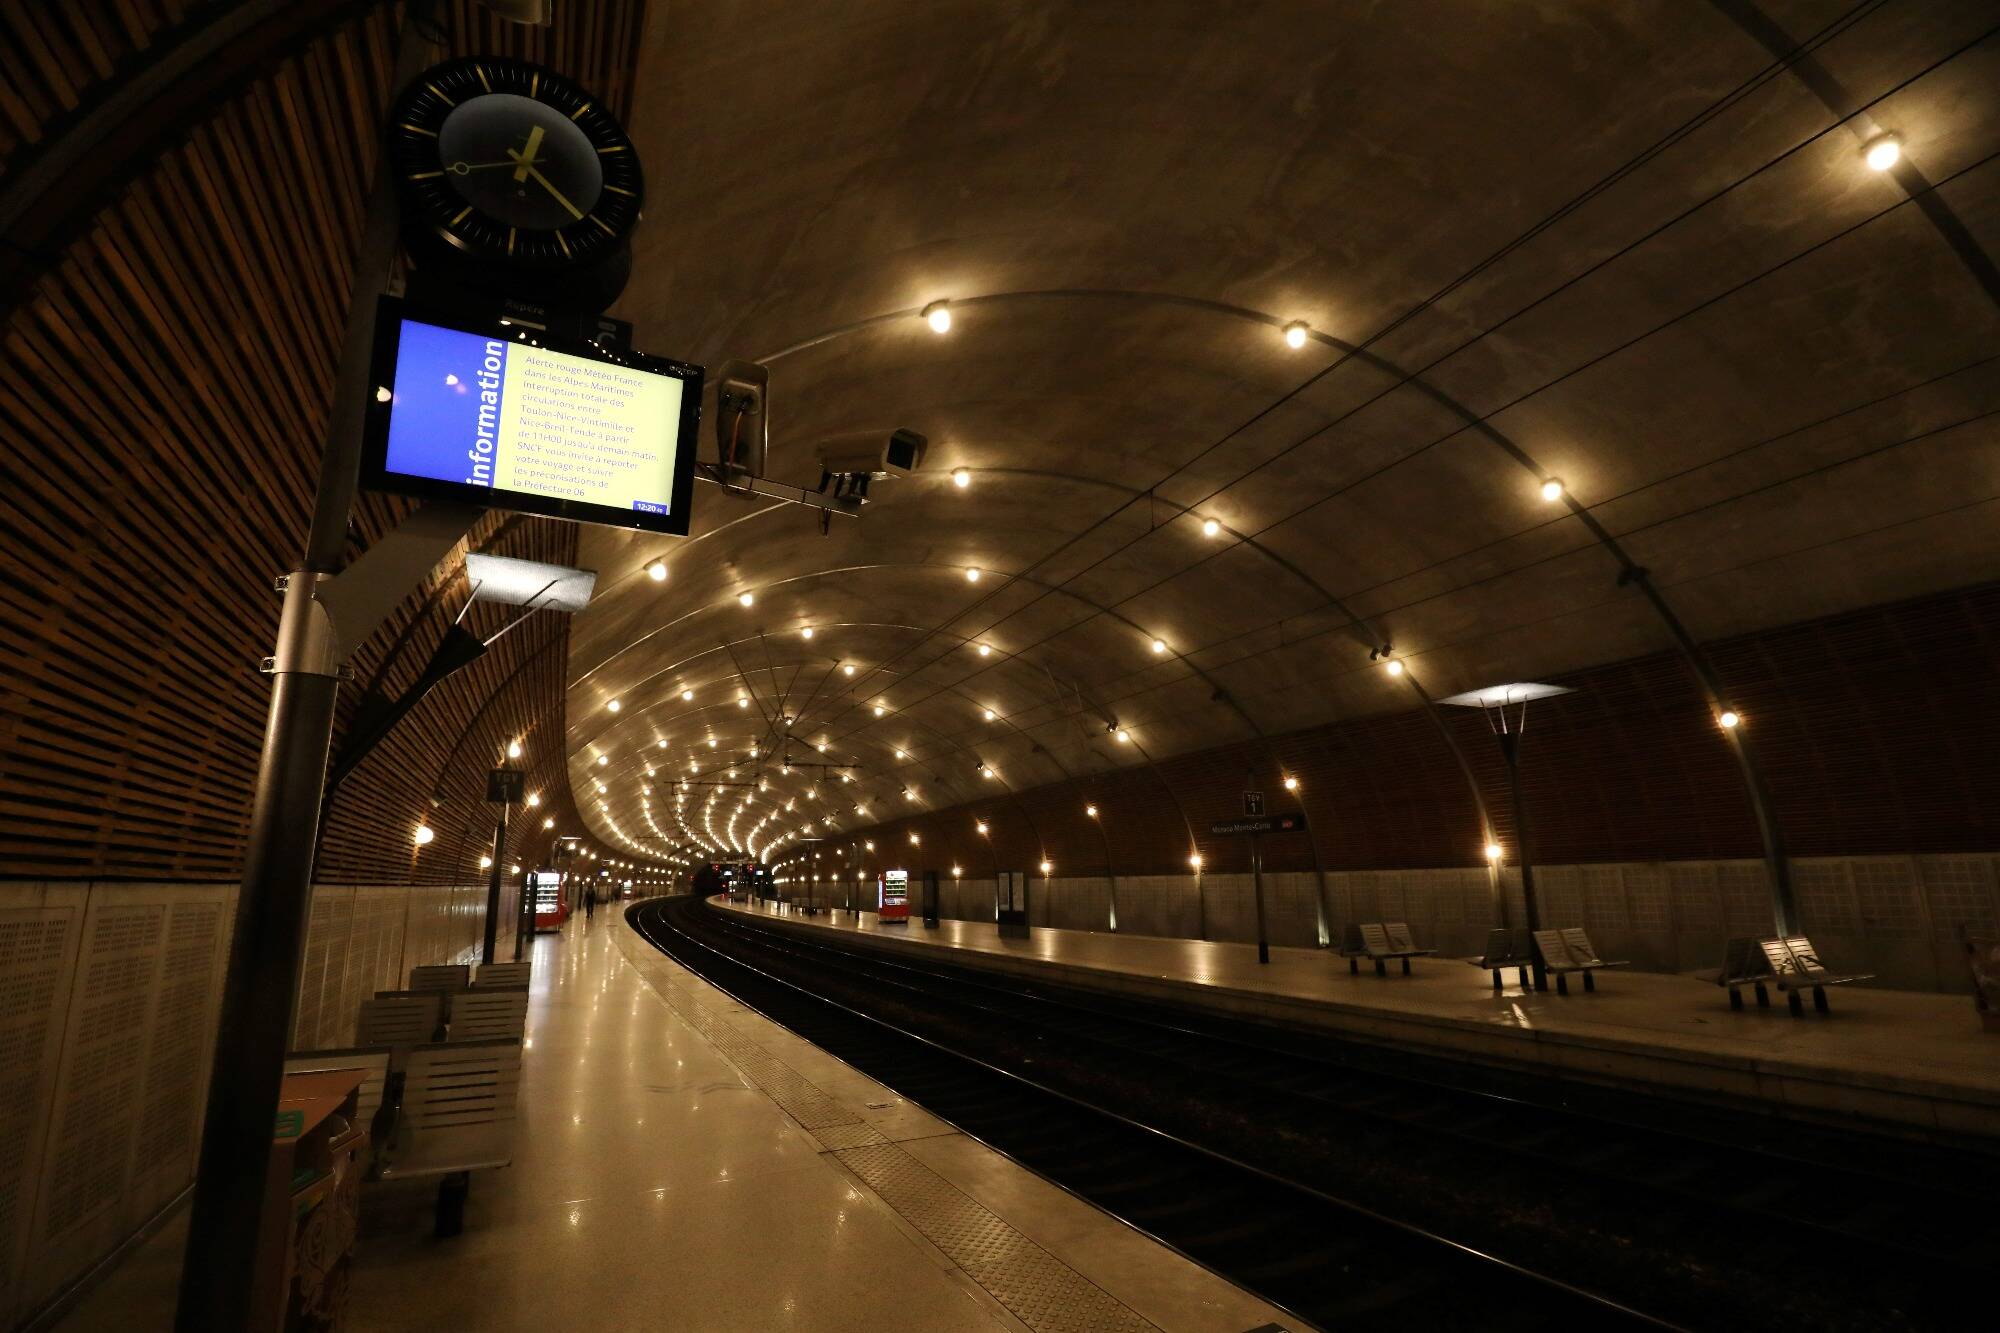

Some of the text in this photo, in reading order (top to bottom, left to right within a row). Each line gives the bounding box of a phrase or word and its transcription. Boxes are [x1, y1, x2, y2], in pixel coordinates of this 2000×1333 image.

[526, 356, 554, 368] Alerte
[556, 364, 582, 375] rouge
[614, 374, 644, 387] France
[524, 369, 634, 398] dans les Alpes Maritimes
[522, 394, 600, 414] circulations entre
[581, 393, 608, 404] totale
[465, 340, 503, 487] information
[606, 434, 630, 444] partir
[518, 442, 542, 452] SNCF
[546, 448, 566, 457] vous
[568, 452, 594, 462] invite
[604, 458, 638, 470] reporter
[598, 444, 630, 456] demain
[516, 456, 540, 464] votre
[542, 460, 574, 472] voyage
[588, 468, 614, 478] suivre
[513, 478, 522, 486] la
[574, 488, 584, 496] 06
[530, 470, 596, 486] préconisations
[637, 503, 656, 512] 12:20
[1250, 802, 1256, 813] 1
